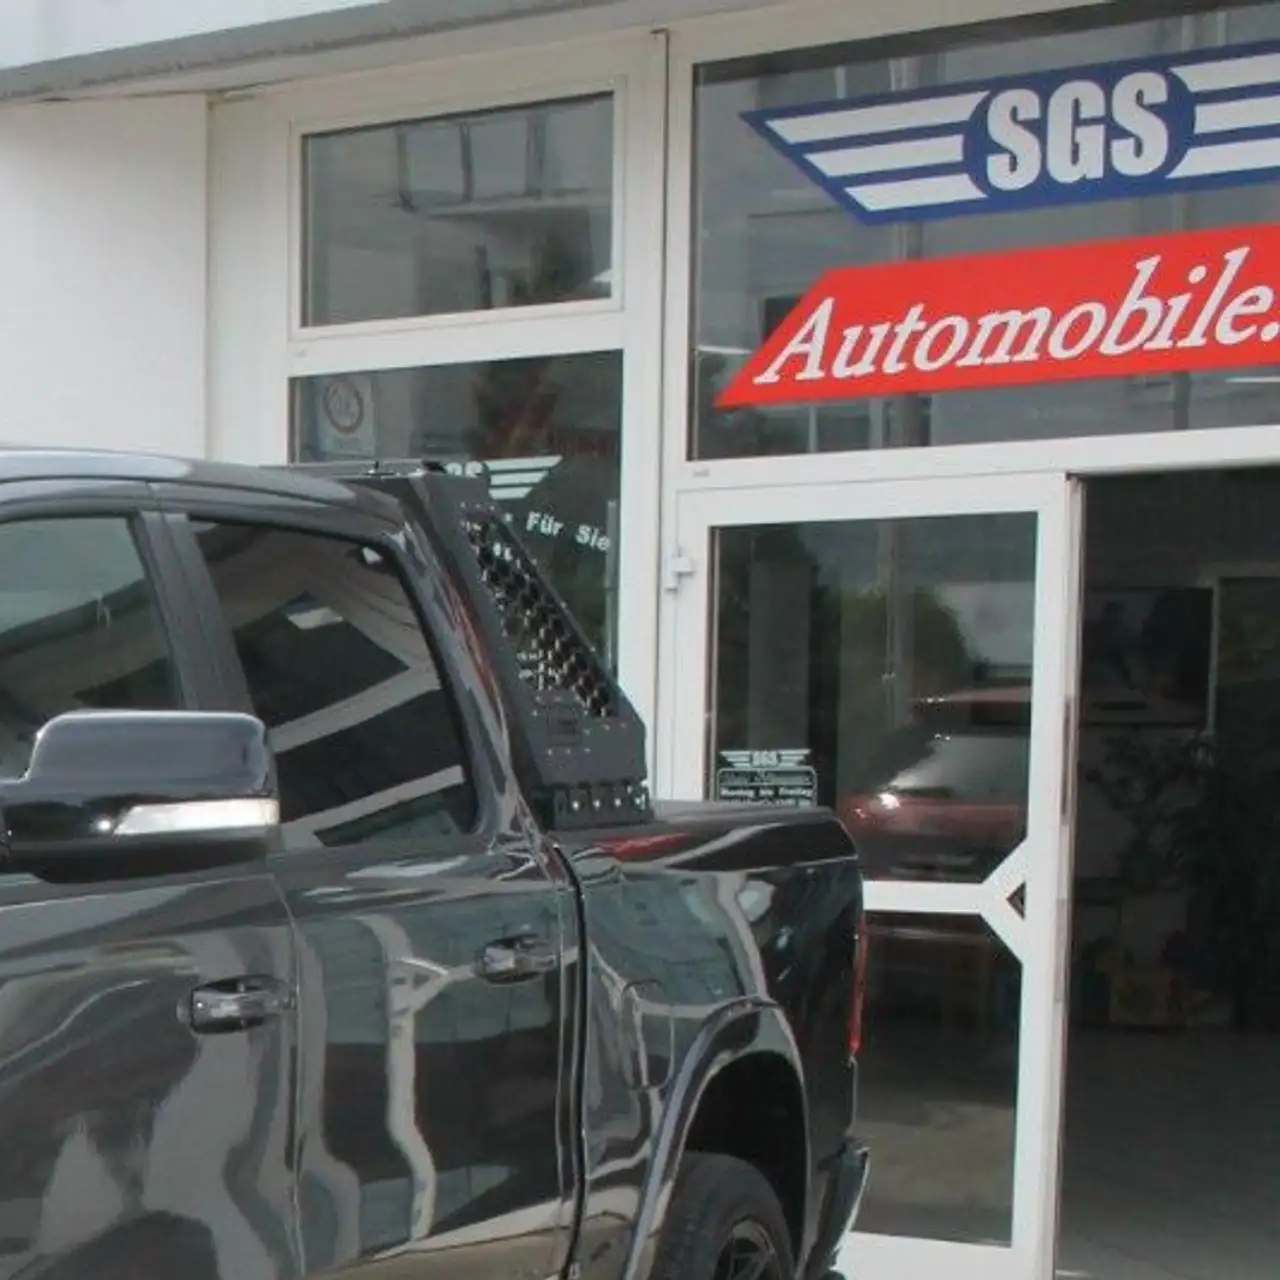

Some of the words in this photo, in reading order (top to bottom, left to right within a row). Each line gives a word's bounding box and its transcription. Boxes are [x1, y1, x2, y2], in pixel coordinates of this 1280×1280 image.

[986, 71, 1170, 191] SGS
[526, 511, 564, 537] Für
[575, 524, 611, 551] Sie
